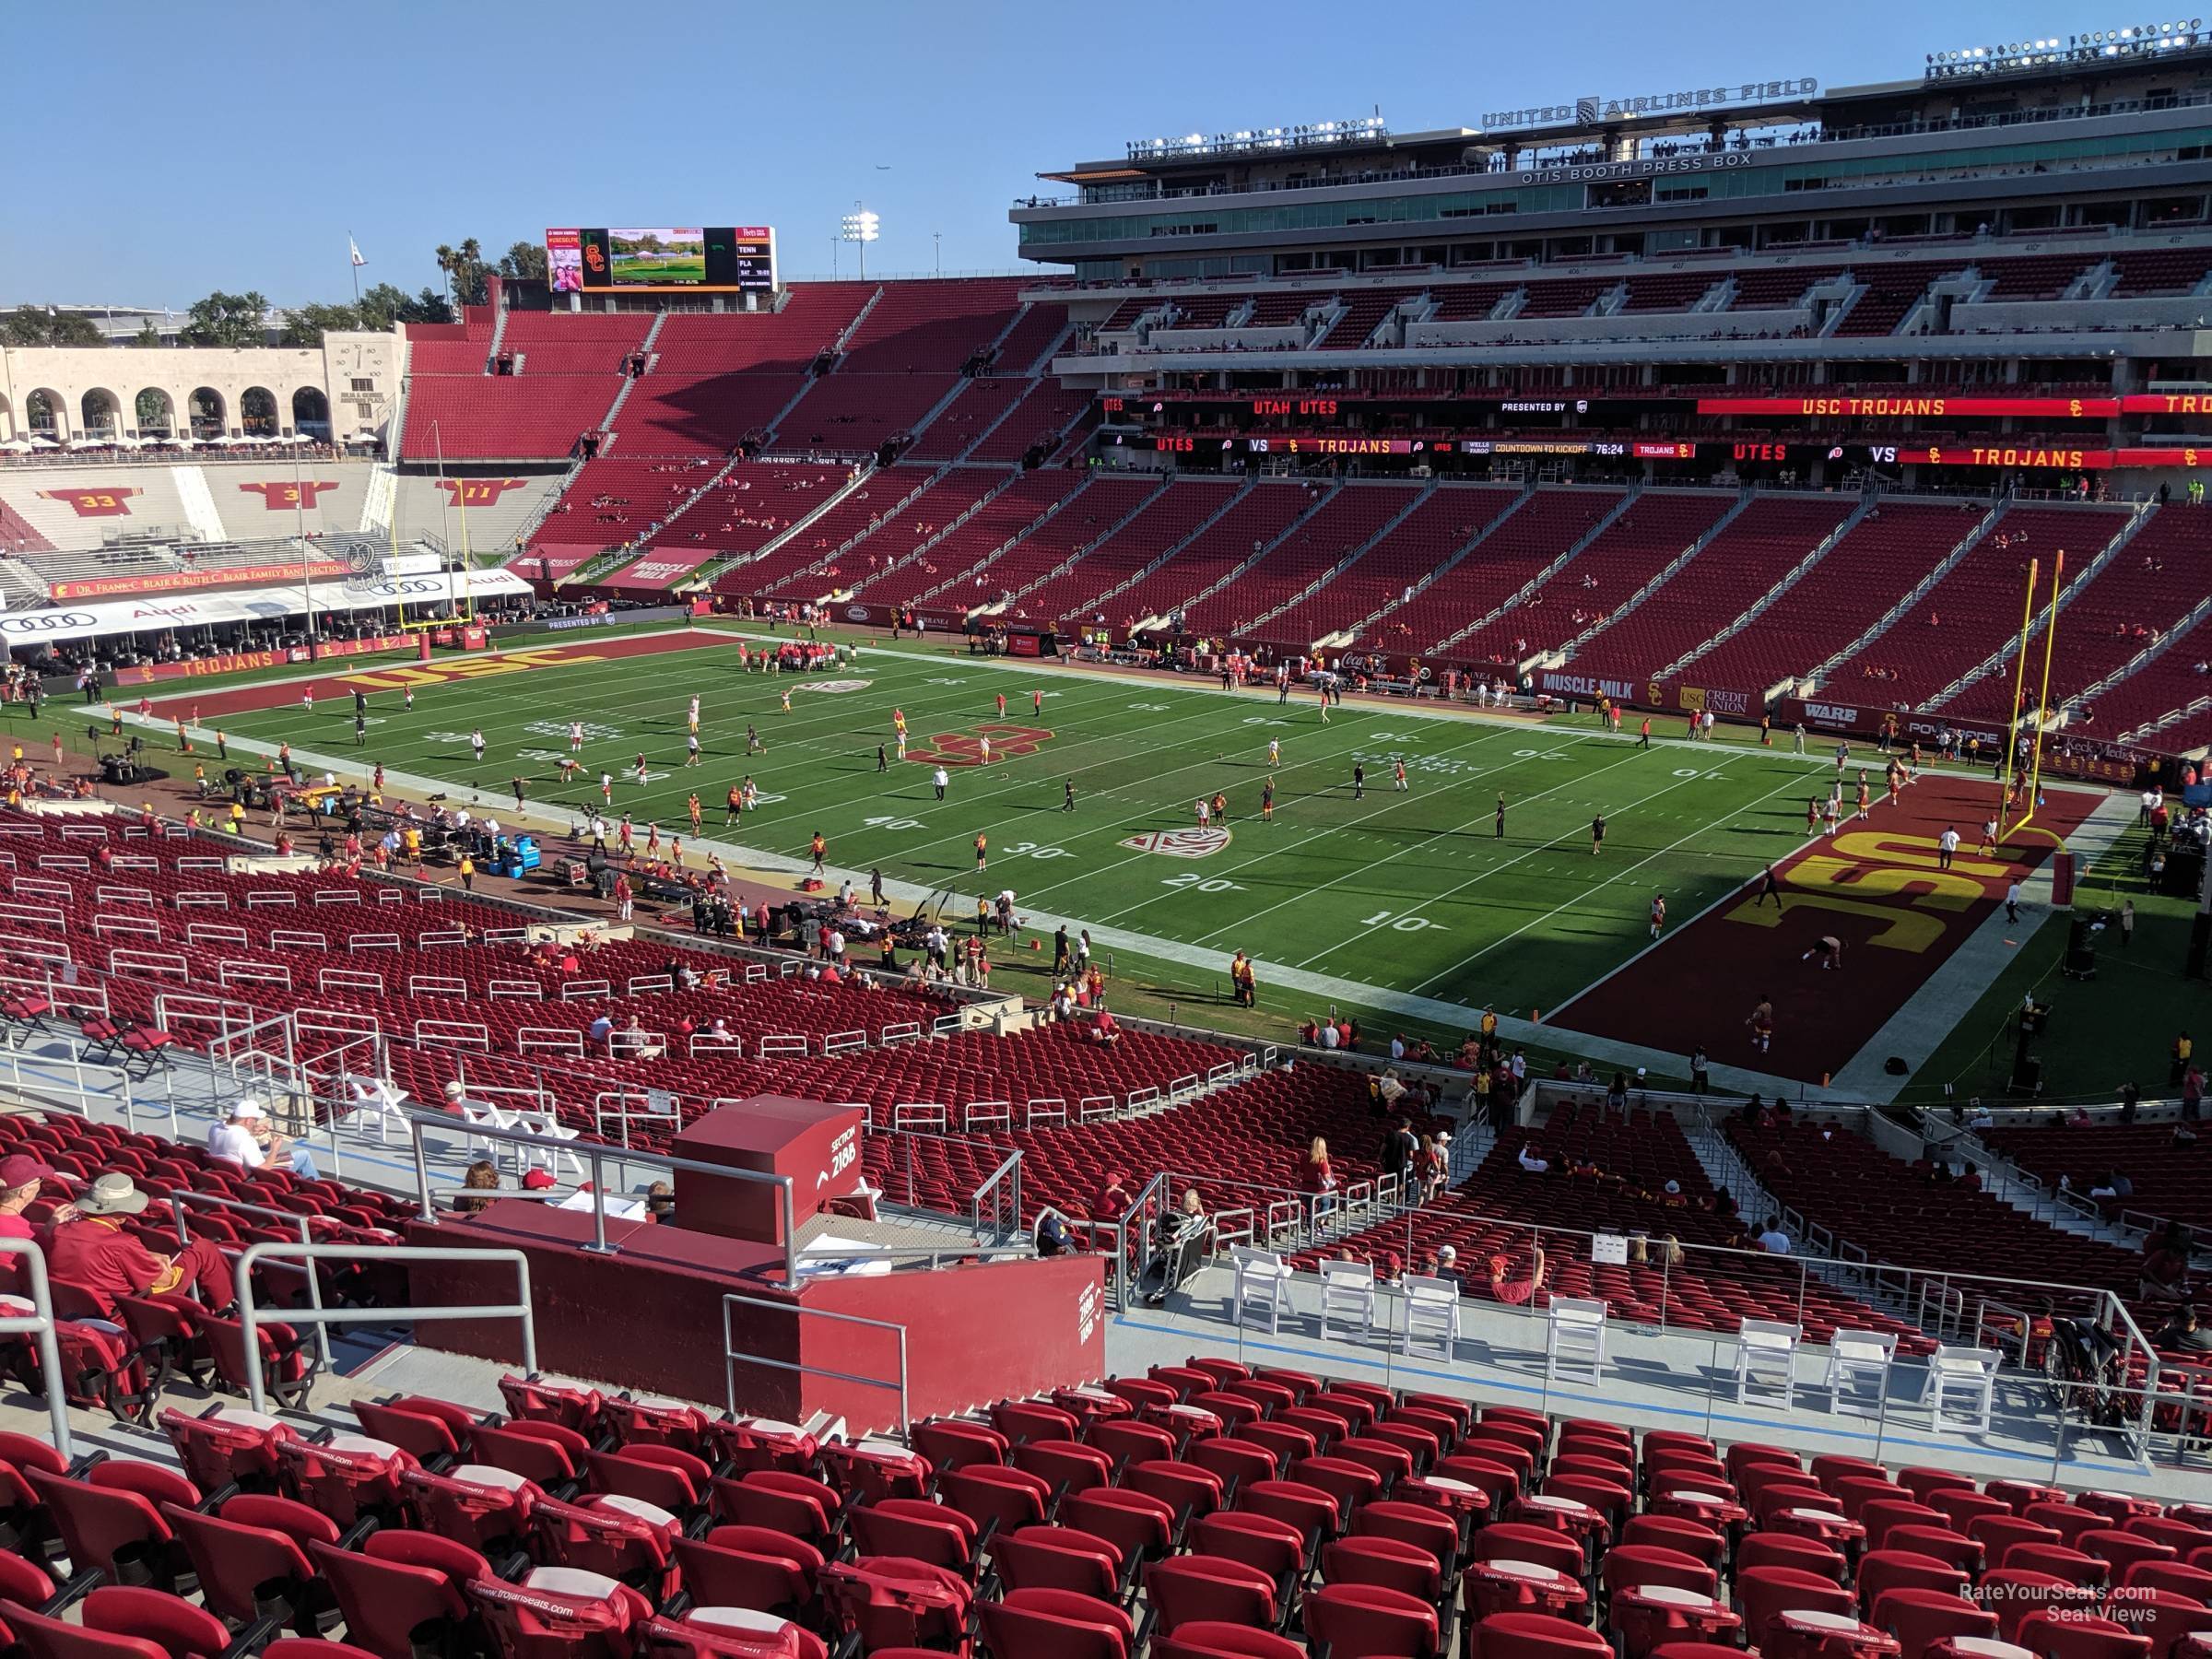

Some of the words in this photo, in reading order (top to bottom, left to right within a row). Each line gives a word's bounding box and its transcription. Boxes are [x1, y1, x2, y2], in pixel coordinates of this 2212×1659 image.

[1482, 105, 1571, 128] UNITED
[1605, 88, 1726, 116] AIRLINES
[1741, 77, 1818, 100] FIELD
[1522, 171, 1561, 184] OTIS
[1571, 164, 1632, 180] BOOTH
[1642, 158, 1702, 173] PRESS
[1713, 152, 1753, 167] BOX
[1103, 398, 1124, 412] UTES
[1253, 401, 1290, 414] UTAH
[1300, 401, 1337, 414] UTES
[1501, 403, 1551, 412] PRESENTED
[1554, 403, 1566, 412] BY
[1802, 399, 1841, 416] USC
[1849, 399, 1946, 416] TROJANS
[1157, 438, 1194, 452] UTES
[1252, 439, 1267, 452] VS
[1318, 440, 1391, 453] TROJANS
[1495, 443, 1543, 453] COUNTDOWN
[1544, 444, 1554, 453] TO
[1555, 444, 1588, 454] KICKOFF
[1595, 444, 1624, 455] 76:24
[1640, 445, 1675, 455] TROJANS
[1733, 444, 1787, 460] UTES
[1871, 446, 1897, 463] VS
[1972, 449, 2084, 467] TROJANS
[284, 489, 300, 500] 3
[465, 487, 489, 499] 11
[78, 495, 116, 508] 33
[633, 560, 695, 573] MUSCLE
[96, 582, 130, 593] FRANK
[143, 577, 171, 589] BLAIR
[171, 576, 182, 587] &
[182, 574, 209, 586] RUTH
[223, 571, 250, 582] BLAIR
[250, 568, 282, 581] FAMILY
[307, 564, 346, 576] SECTION
[347, 571, 386, 591] Allstate
[467, 573, 516, 586] Audi
[629, 569, 673, 581] MILK
[133, 604, 199, 619] Audi
[548, 618, 590, 630] PRESENTED
[590, 617, 600, 627] BY
[1007, 621, 1034, 630] Pharmacy
[181, 653, 274, 677] TROJANS
[332, 649, 607, 688] USC
[1543, 673, 1595, 695] MUSCLE
[1599, 679, 1633, 700] MILK
[1681, 692, 1704, 704] USC
[1706, 688, 1749, 703] CREDIT
[1706, 700, 1747, 714] UNION
[1805, 703, 1858, 724] WARE
[2065, 737, 2094, 753] Keck
[515, 748, 566, 761] 30
[1671, 768, 1725, 781] 10
[863, 816, 920, 830] 40
[1002, 841, 1066, 859] 30
[1159, 873, 1233, 892] 20
[1359, 911, 1430, 932] 10
[831, 1124, 855, 1153] SECTION
[831, 1142, 856, 1180] 218B
